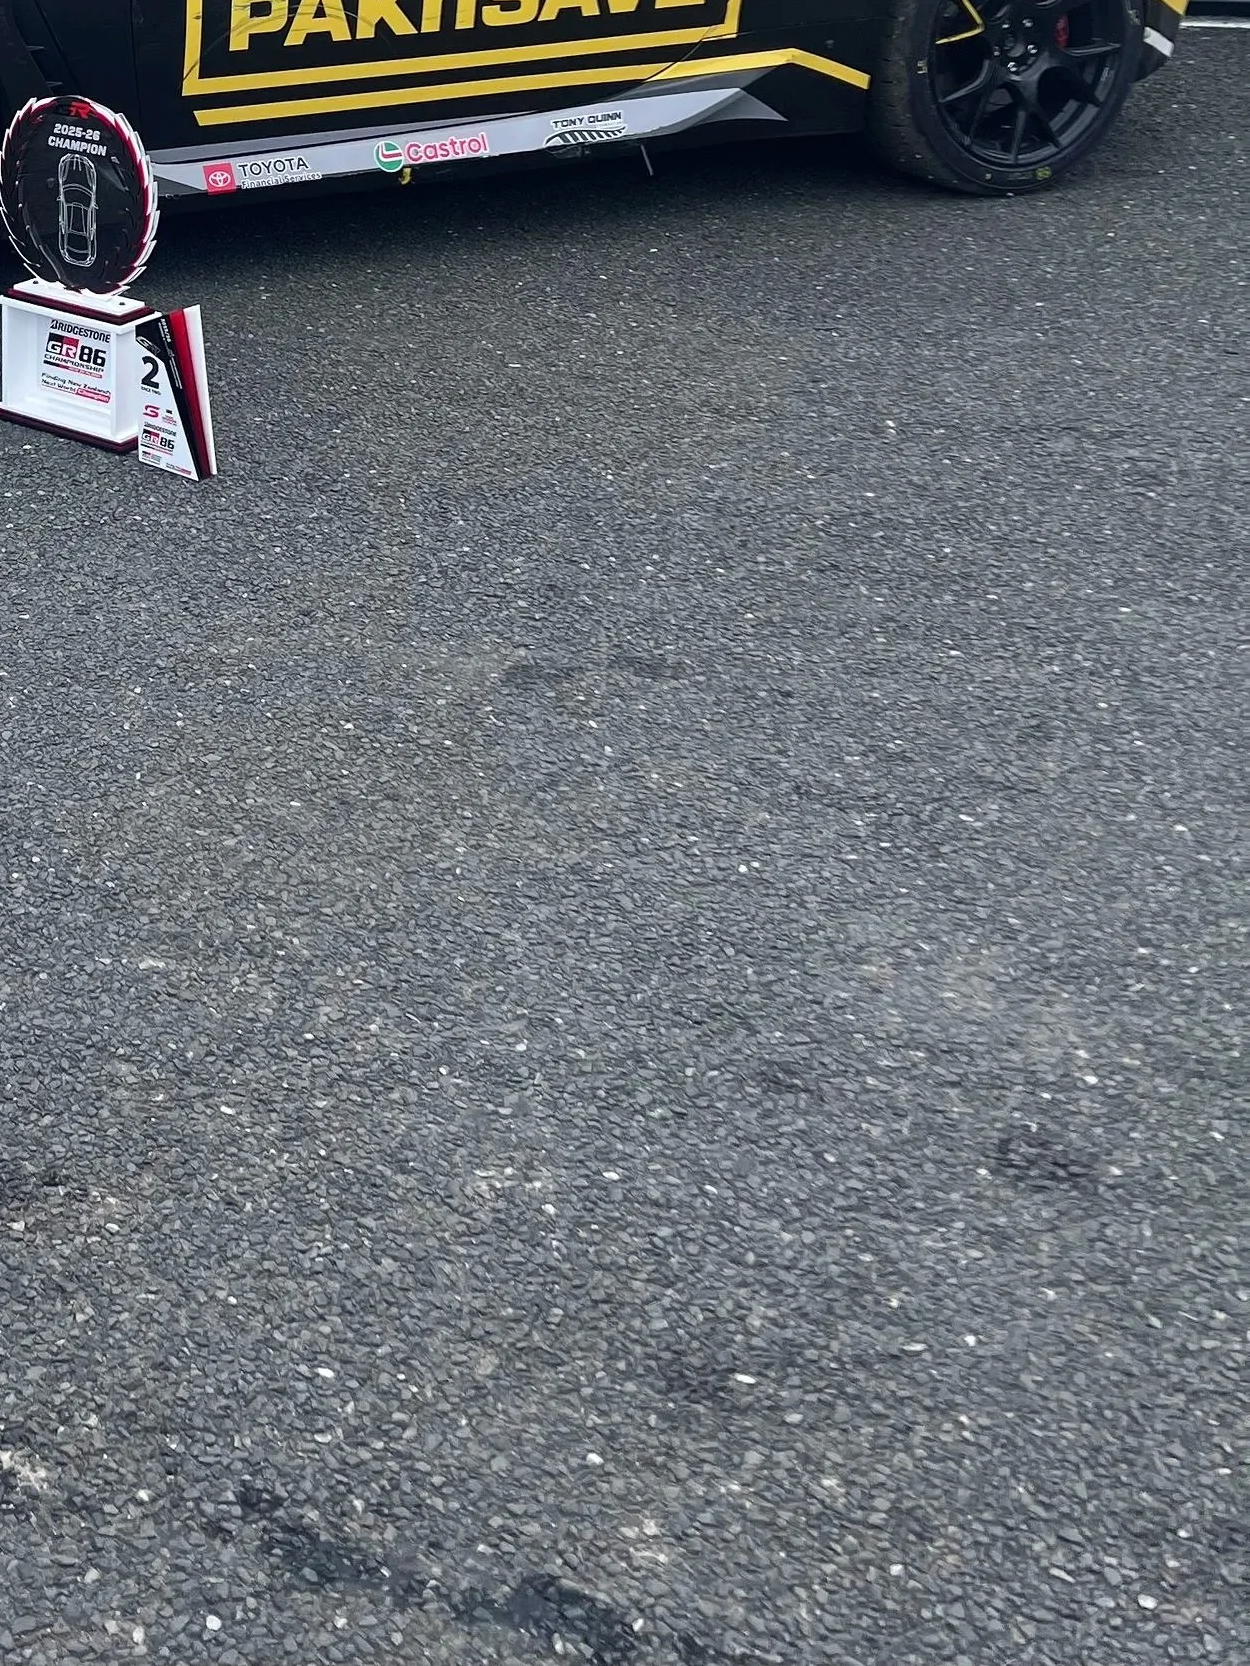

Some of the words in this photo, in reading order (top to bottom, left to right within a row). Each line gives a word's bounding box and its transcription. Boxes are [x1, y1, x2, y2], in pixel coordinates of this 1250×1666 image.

[552, 116, 585, 129] TONY
[587, 111, 622, 124] QUINN
[53, 123, 101, 141] 2025-26
[48, 135, 108, 157] CHAMPION
[405, 132, 489, 163] Castrol
[238, 156, 309, 178] TOYOTA
[242, 175, 283, 189] Financial
[284, 171, 323, 185] Services
[50, 319, 112, 344] BRIDGESTONE
[44, 354, 104, 373] CHAMPIONSHIP
[141, 355, 160, 389] 2
